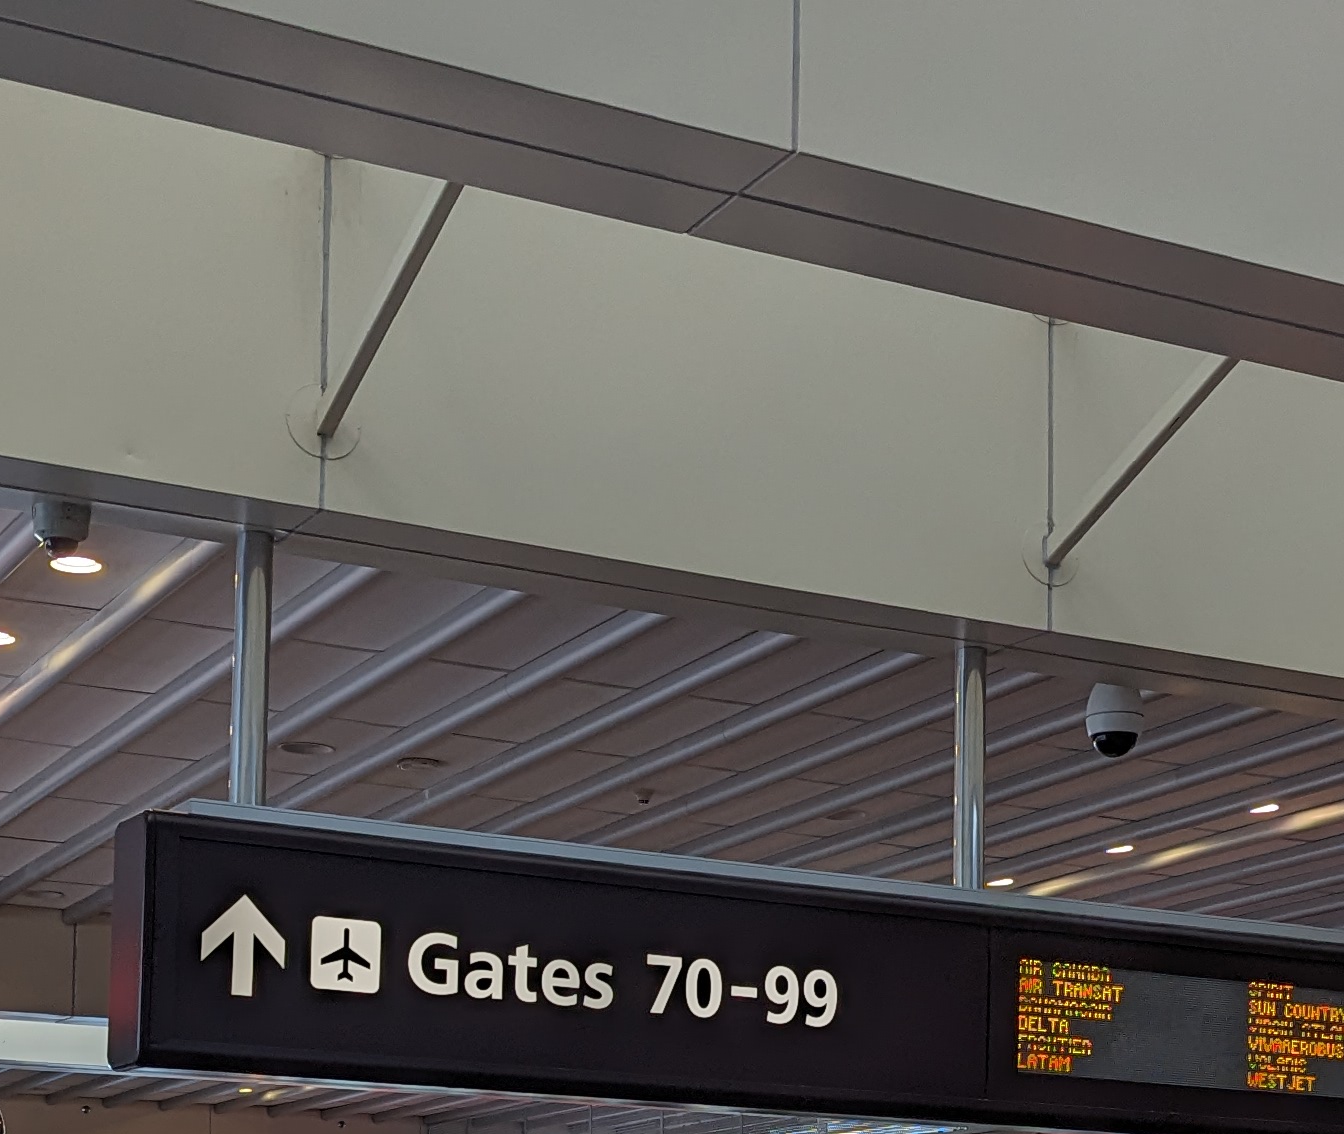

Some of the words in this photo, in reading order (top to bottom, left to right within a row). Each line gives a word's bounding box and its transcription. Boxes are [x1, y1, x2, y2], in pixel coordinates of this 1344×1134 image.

[408, 932, 614, 1009] Gates
[646, 953, 838, 1028] 70-99
[1018, 959, 1043, 975] AIR
[1052, 961, 1112, 982] CANADA
[1018, 978, 1043, 994] AIR
[1052, 980, 1125, 1003] TRANSAT
[1248, 999, 1276, 1016] SUN
[1018, 1014, 1070, 1034] DELTA
[1017, 1052, 1073, 1073] LATAM
[1247, 1071, 1316, 1092] WESTJET
